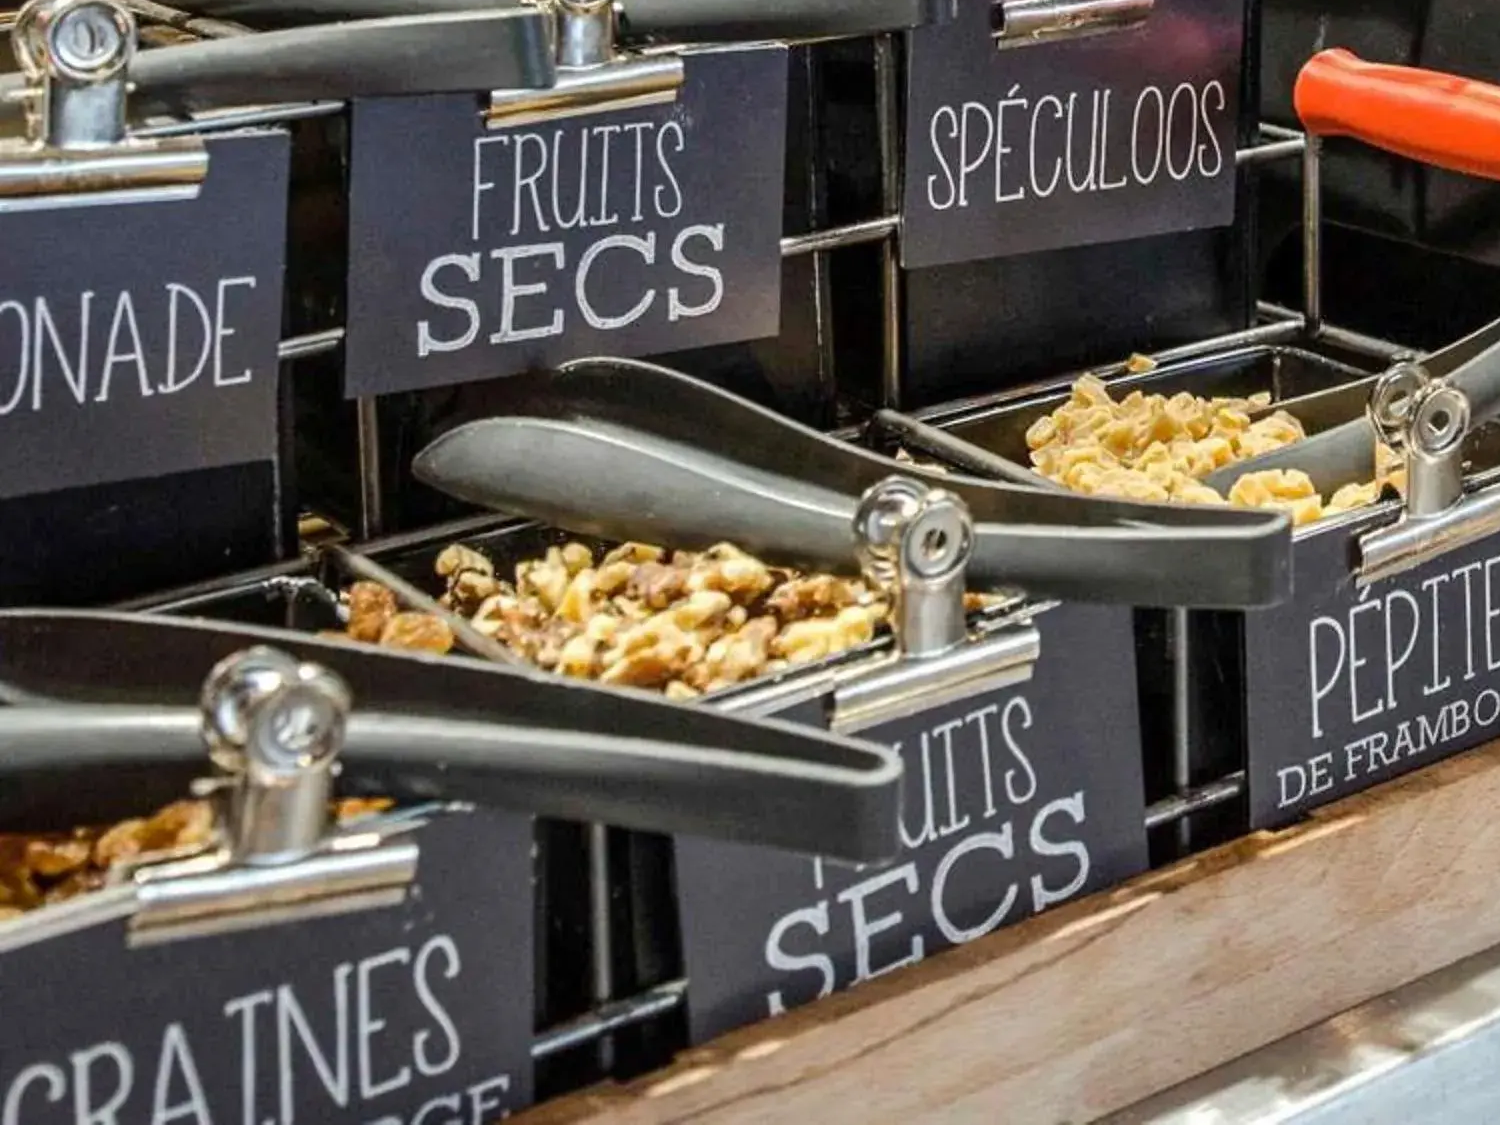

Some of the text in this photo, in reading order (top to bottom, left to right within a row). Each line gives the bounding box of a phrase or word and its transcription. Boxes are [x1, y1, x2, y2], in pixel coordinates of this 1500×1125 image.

[471, 120, 685, 239] FRUITS
[926, 80, 1226, 210] SPÉCULOOS
[416, 223, 726, 357] SECS
[1277, 753, 1333, 808] DE
[765, 790, 1091, 1017] SECS
